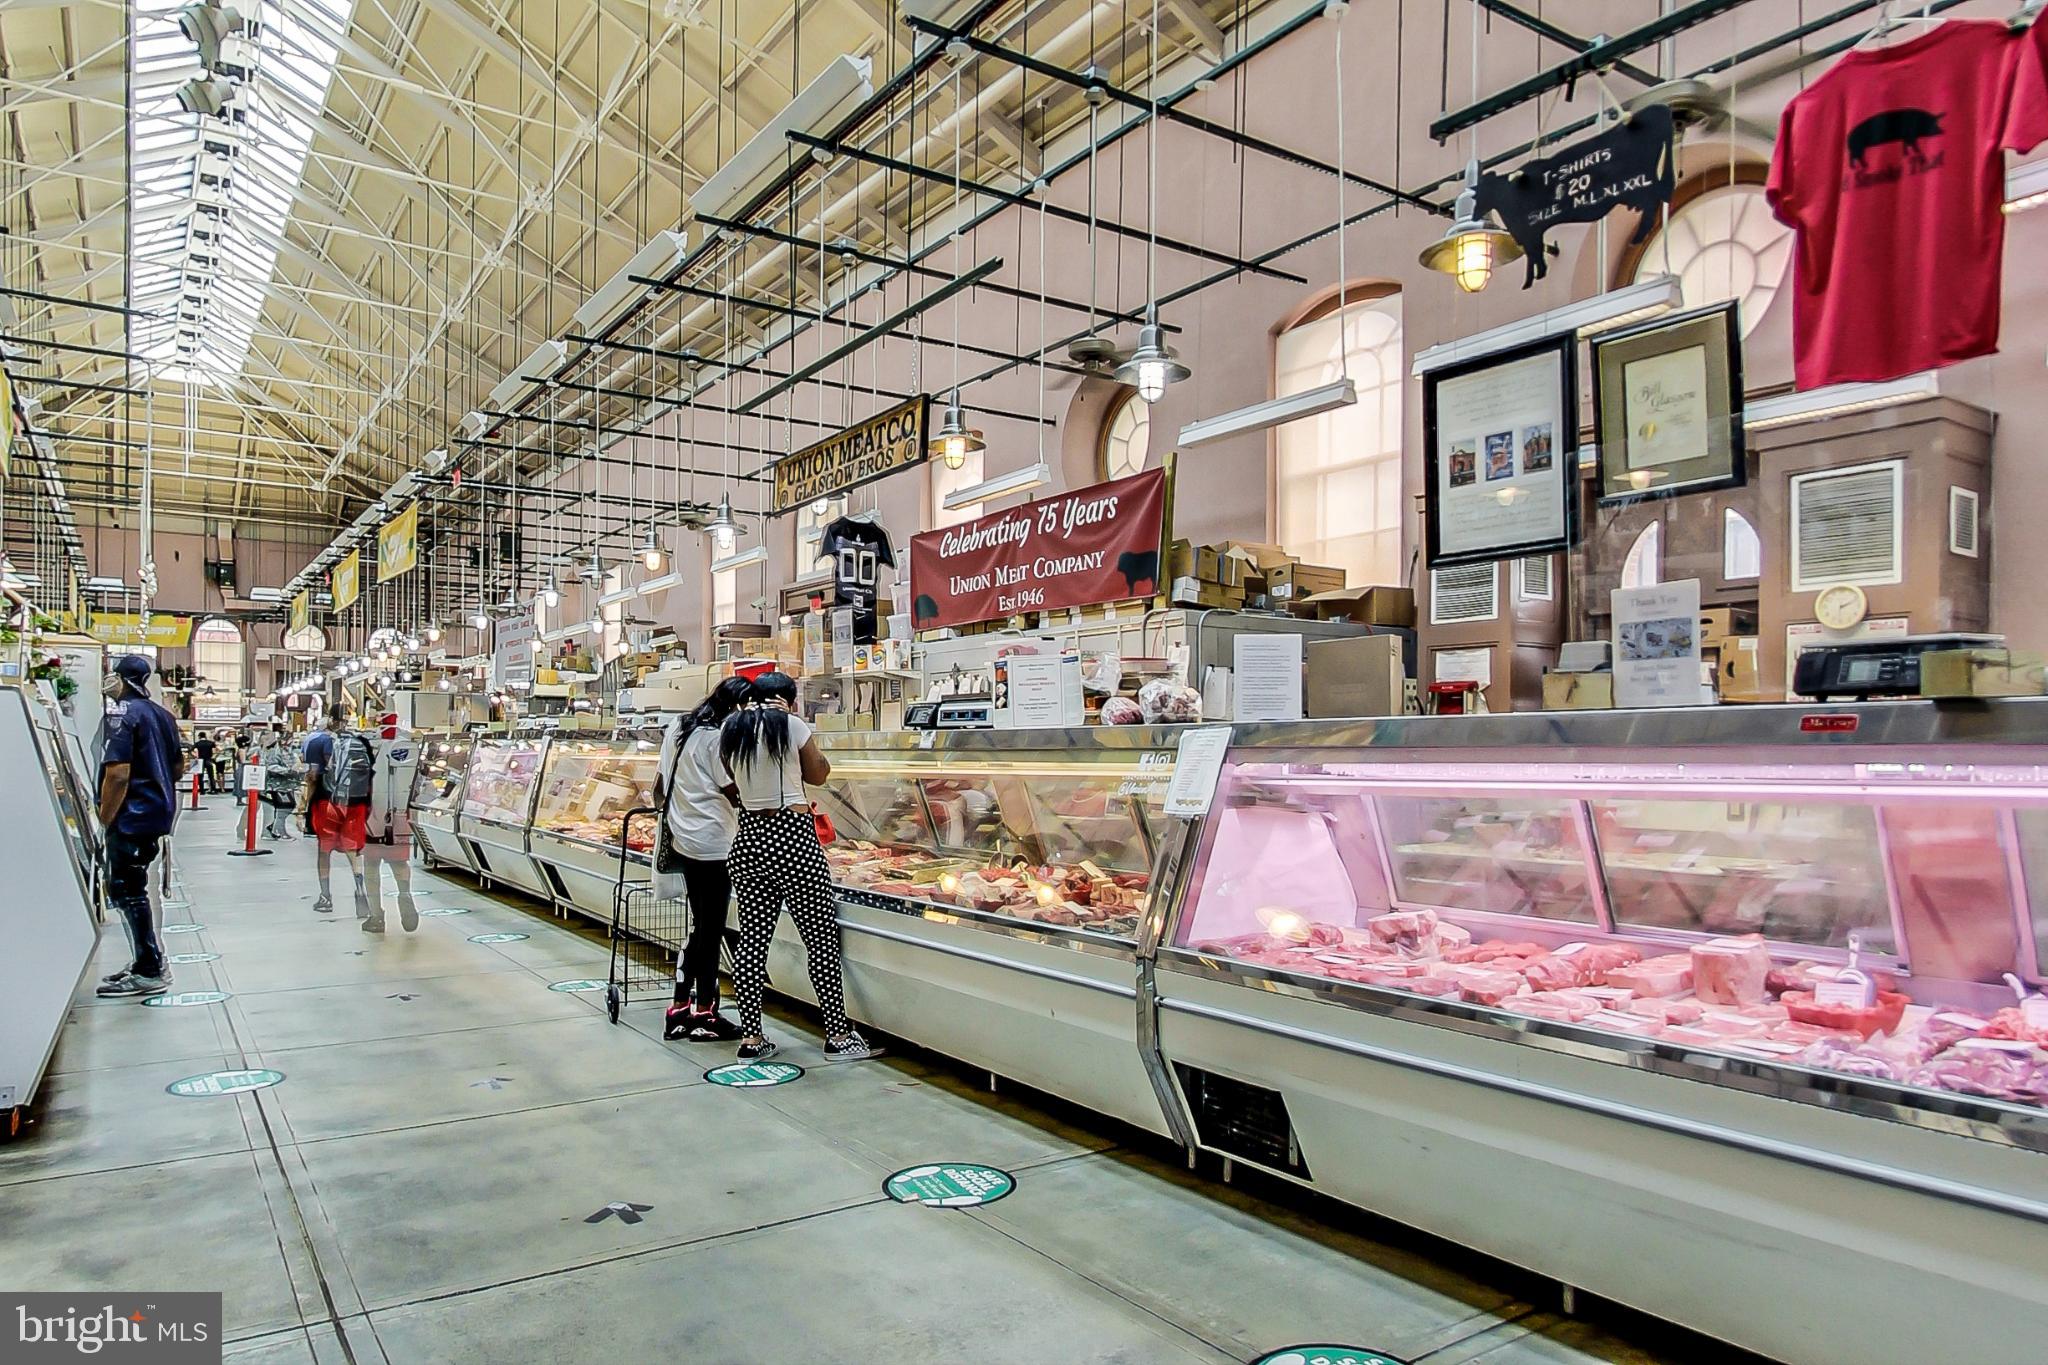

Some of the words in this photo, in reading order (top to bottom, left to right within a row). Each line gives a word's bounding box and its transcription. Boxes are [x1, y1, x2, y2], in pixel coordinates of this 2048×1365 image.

[1543, 148, 1612, 185] T-SHIRTS
[1528, 203, 1562, 226] SIZE
[1623, 174, 1653, 191] XXL
[786, 444, 835, 486] UNION
[837, 422, 886, 466] MEAT
[794, 464, 855, 502] GLASGOW
[857, 447, 895, 479] BROS
[940, 515, 1032, 559] Celebrating
[1037, 502, 1060, 535] 75
[1063, 496, 1119, 539] Years
[840, 548, 876, 585] 00
[950, 572, 991, 596] UNION
[1033, 550, 1106, 578] COMPANY
